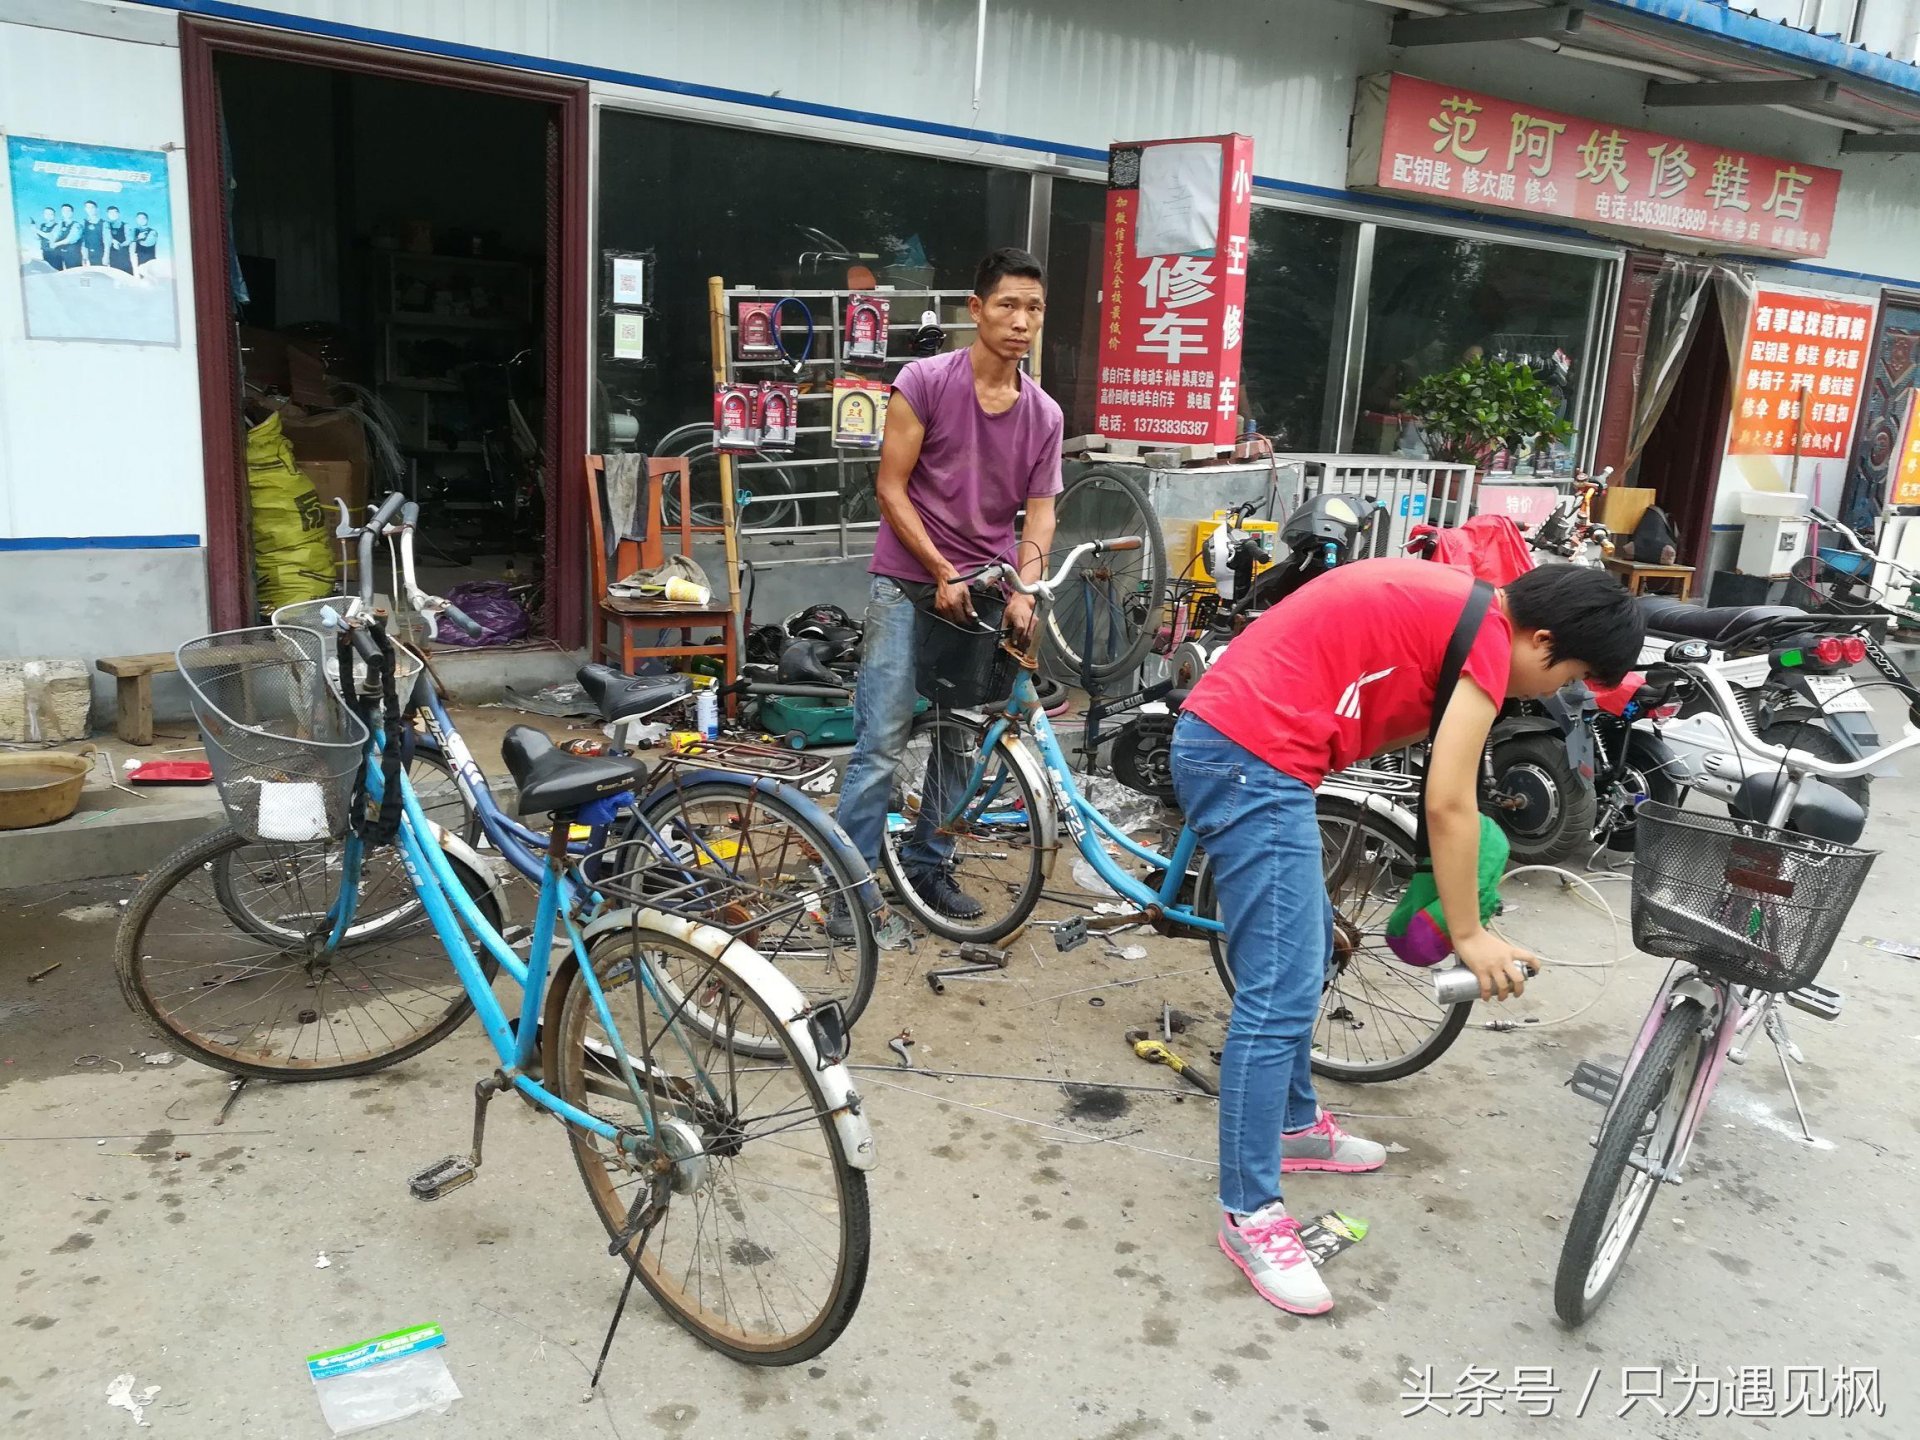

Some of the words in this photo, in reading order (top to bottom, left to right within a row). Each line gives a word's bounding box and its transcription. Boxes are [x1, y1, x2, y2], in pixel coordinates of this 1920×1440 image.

[1428, 95, 1813, 221] 范阿姨修鞋店
[1392, 153, 1451, 191] 配钥匙
[1461, 166, 1516, 200] 修衣服
[1524, 178, 1558, 207] 修伞
[1216, 159, 1250, 421] 小王修车
[1136, 256, 1217, 364] 修车
[1756, 306, 1866, 341] 有事就找范阿姨
[1751, 341, 1790, 363] 配钥匙
[1795, 344, 1819, 365] 修鞋
[1824, 347, 1860, 370] 修衣服
[1102, 367, 1131, 384] 修自行车
[1133, 368, 1163, 385] 修电动车
[1165, 369, 1180, 386] 补胎
[1182, 370, 1214, 388] 换真空胎
[1746, 369, 1785, 391] 修箱子
[1819, 375, 1855, 397] 修拉链
[1100, 388, 1175, 408] 高价回收电动车自行车
[1187, 392, 1212, 410] 换电瓶
[1741, 397, 1769, 420] 修伞
[1506, 495, 1533, 514] 特价
